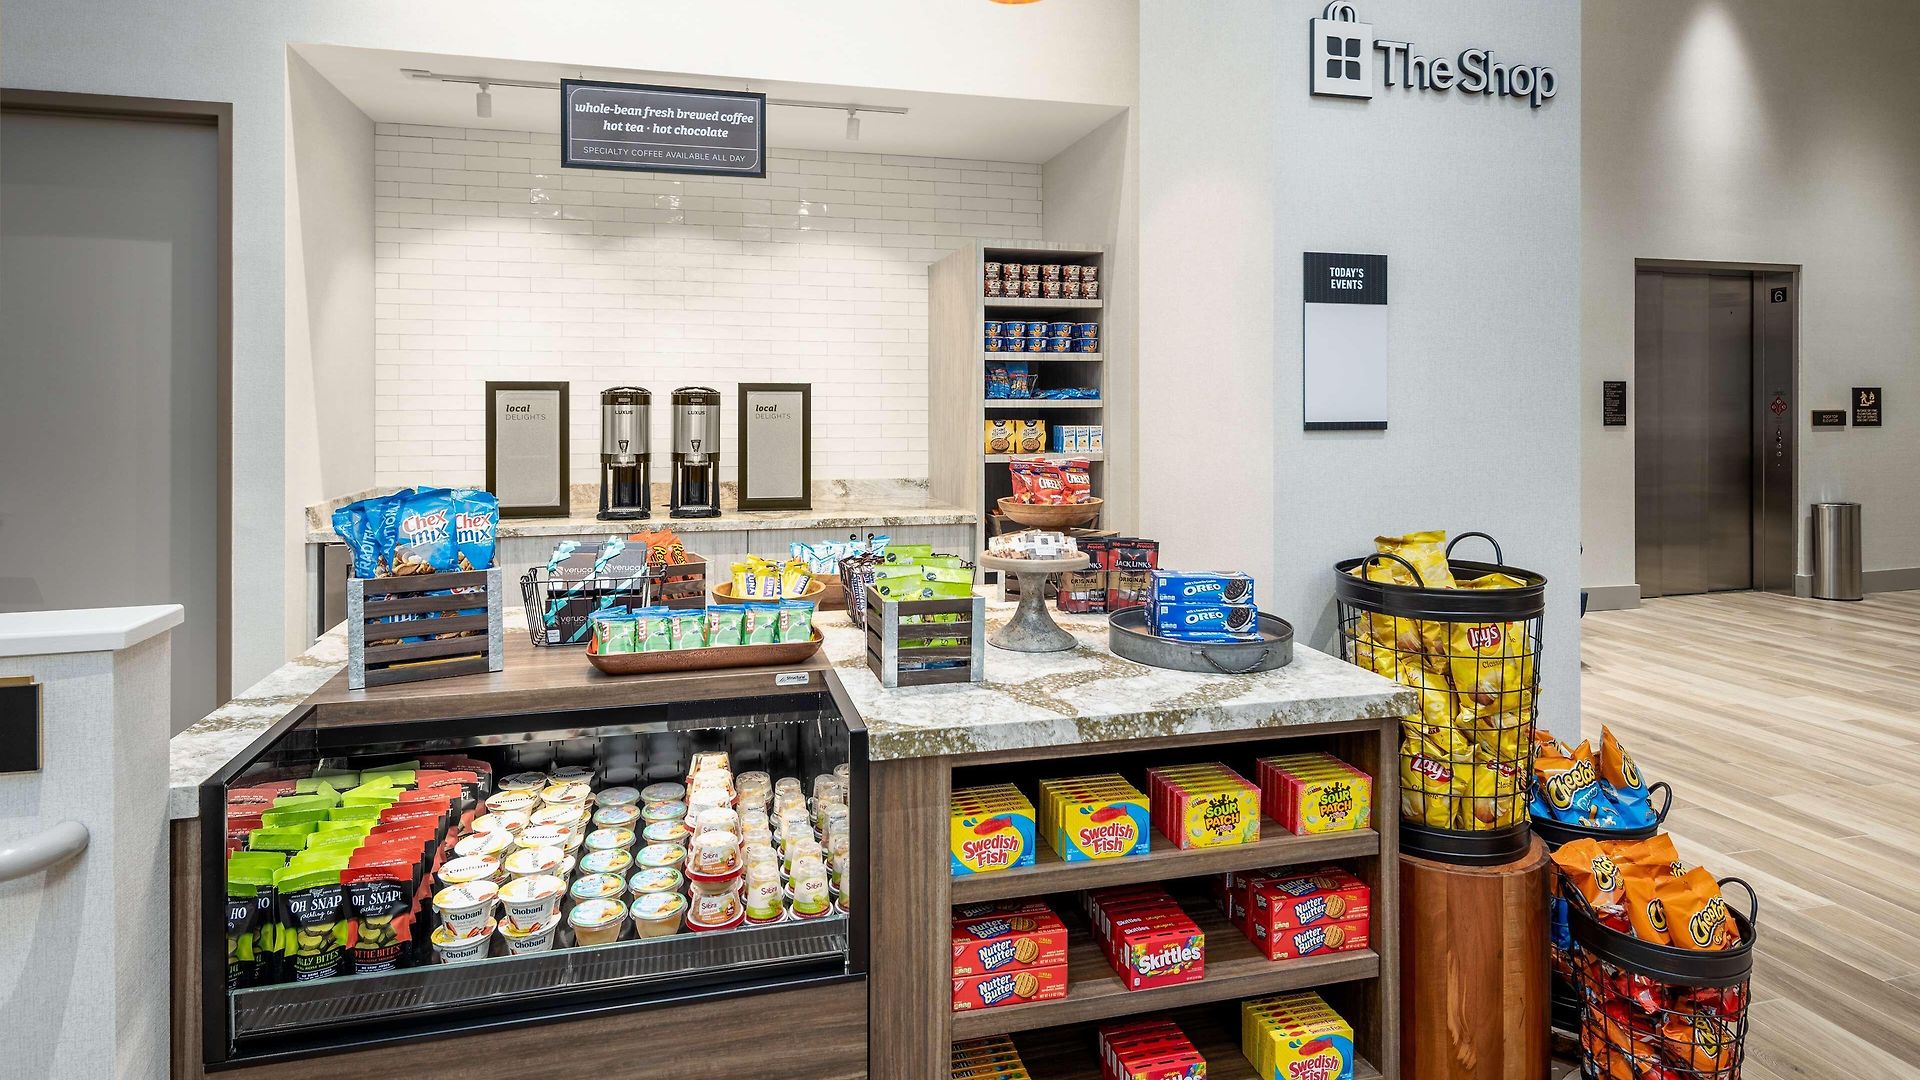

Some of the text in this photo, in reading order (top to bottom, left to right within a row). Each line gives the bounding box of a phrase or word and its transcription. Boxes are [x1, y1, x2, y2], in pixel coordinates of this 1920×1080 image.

[1373, 40, 1559, 109] The Shop
[575, 103, 754, 125] whole-bean fresh brewed coffee
[603, 120, 728, 138] hot tea hot chocolate
[583, 146, 629, 156] SPECIALTY
[631, 149, 663, 158] COFFEE
[665, 151, 709, 161] AVAILABLE
[712, 154, 727, 162] ALL
[1330, 267, 1364, 278] TODAY'S
[1331, 278, 1363, 290] EVENTS
[1774, 291, 1783, 302] 6
[505, 403, 531, 414] local
[755, 404, 777, 414] local
[755, 413, 791, 421] DELIGHTS
[505, 413, 547, 422] DELIGHTS
[403, 509, 447, 533] Chex
[456, 512, 493, 530] Chex
[611, 563, 641, 572] veruca
[1183, 583, 1221, 597] OREO
[1185, 611, 1224, 625] OREO
[1320, 790, 1350, 805] SOUR
[1206, 802, 1237, 818] SOUR
[1319, 800, 1352, 817] PATCH
[1205, 812, 1239, 830] PATCH
[1079, 823, 1134, 847] Swedish
[962, 834, 1019, 860] Swedish
[1092, 837, 1124, 854] Fish
[976, 848, 1008, 868] Fish
[291, 894, 343, 914] OH SNAP
[352, 894, 365, 906] OH
[1295, 896, 1323, 916] Nutter
[449, 908, 483, 921] Chobani
[511, 905, 543, 915] Chobani
[1300, 903, 1328, 925] Butter
[967, 919, 1003, 934] Nutter
[976, 923, 1011, 939] Butter
[514, 937, 546, 948] Chobani
[1294, 927, 1322, 946] Nutter
[1299, 934, 1326, 955] Butter
[316, 950, 339, 964] BITES
[446, 947, 479, 959] Chobani
[978, 940, 1012, 960] Nutter
[984, 947, 1016, 970] Butter
[1138, 945, 1202, 975] Skittles
[978, 974, 1012, 995] Nutter
[984, 981, 1016, 1004] Butter
[1287, 1054, 1339, 1079] Swedish
